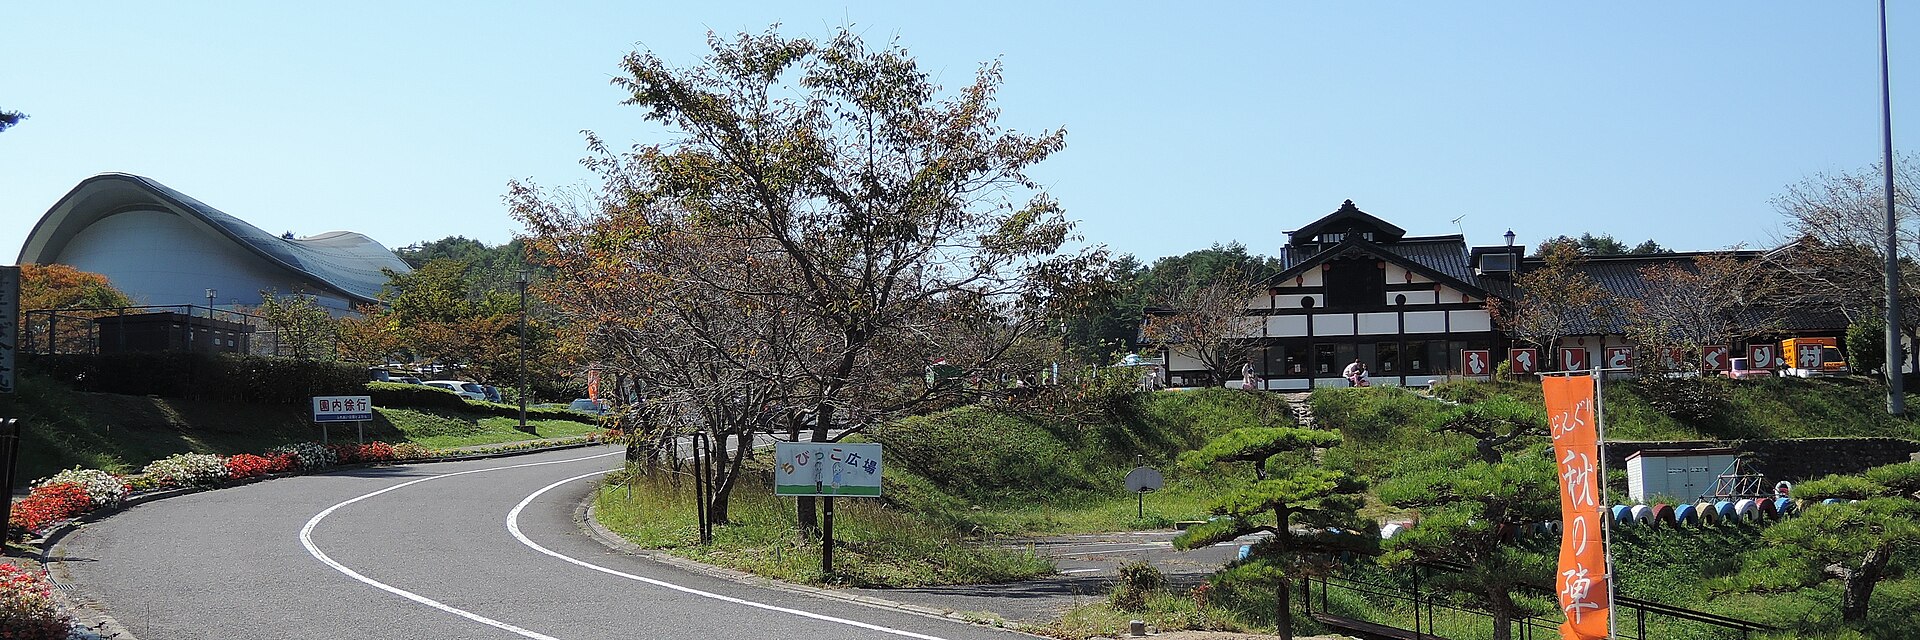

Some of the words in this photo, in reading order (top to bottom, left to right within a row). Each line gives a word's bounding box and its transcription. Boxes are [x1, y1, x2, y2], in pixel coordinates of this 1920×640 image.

[319, 399, 367, 411] 園内徐行
[1551, 397, 1593, 440] どんぐり
[781, 448, 878, 475] ちびっこ広場
[1561, 449, 1598, 625] 秋の陣
